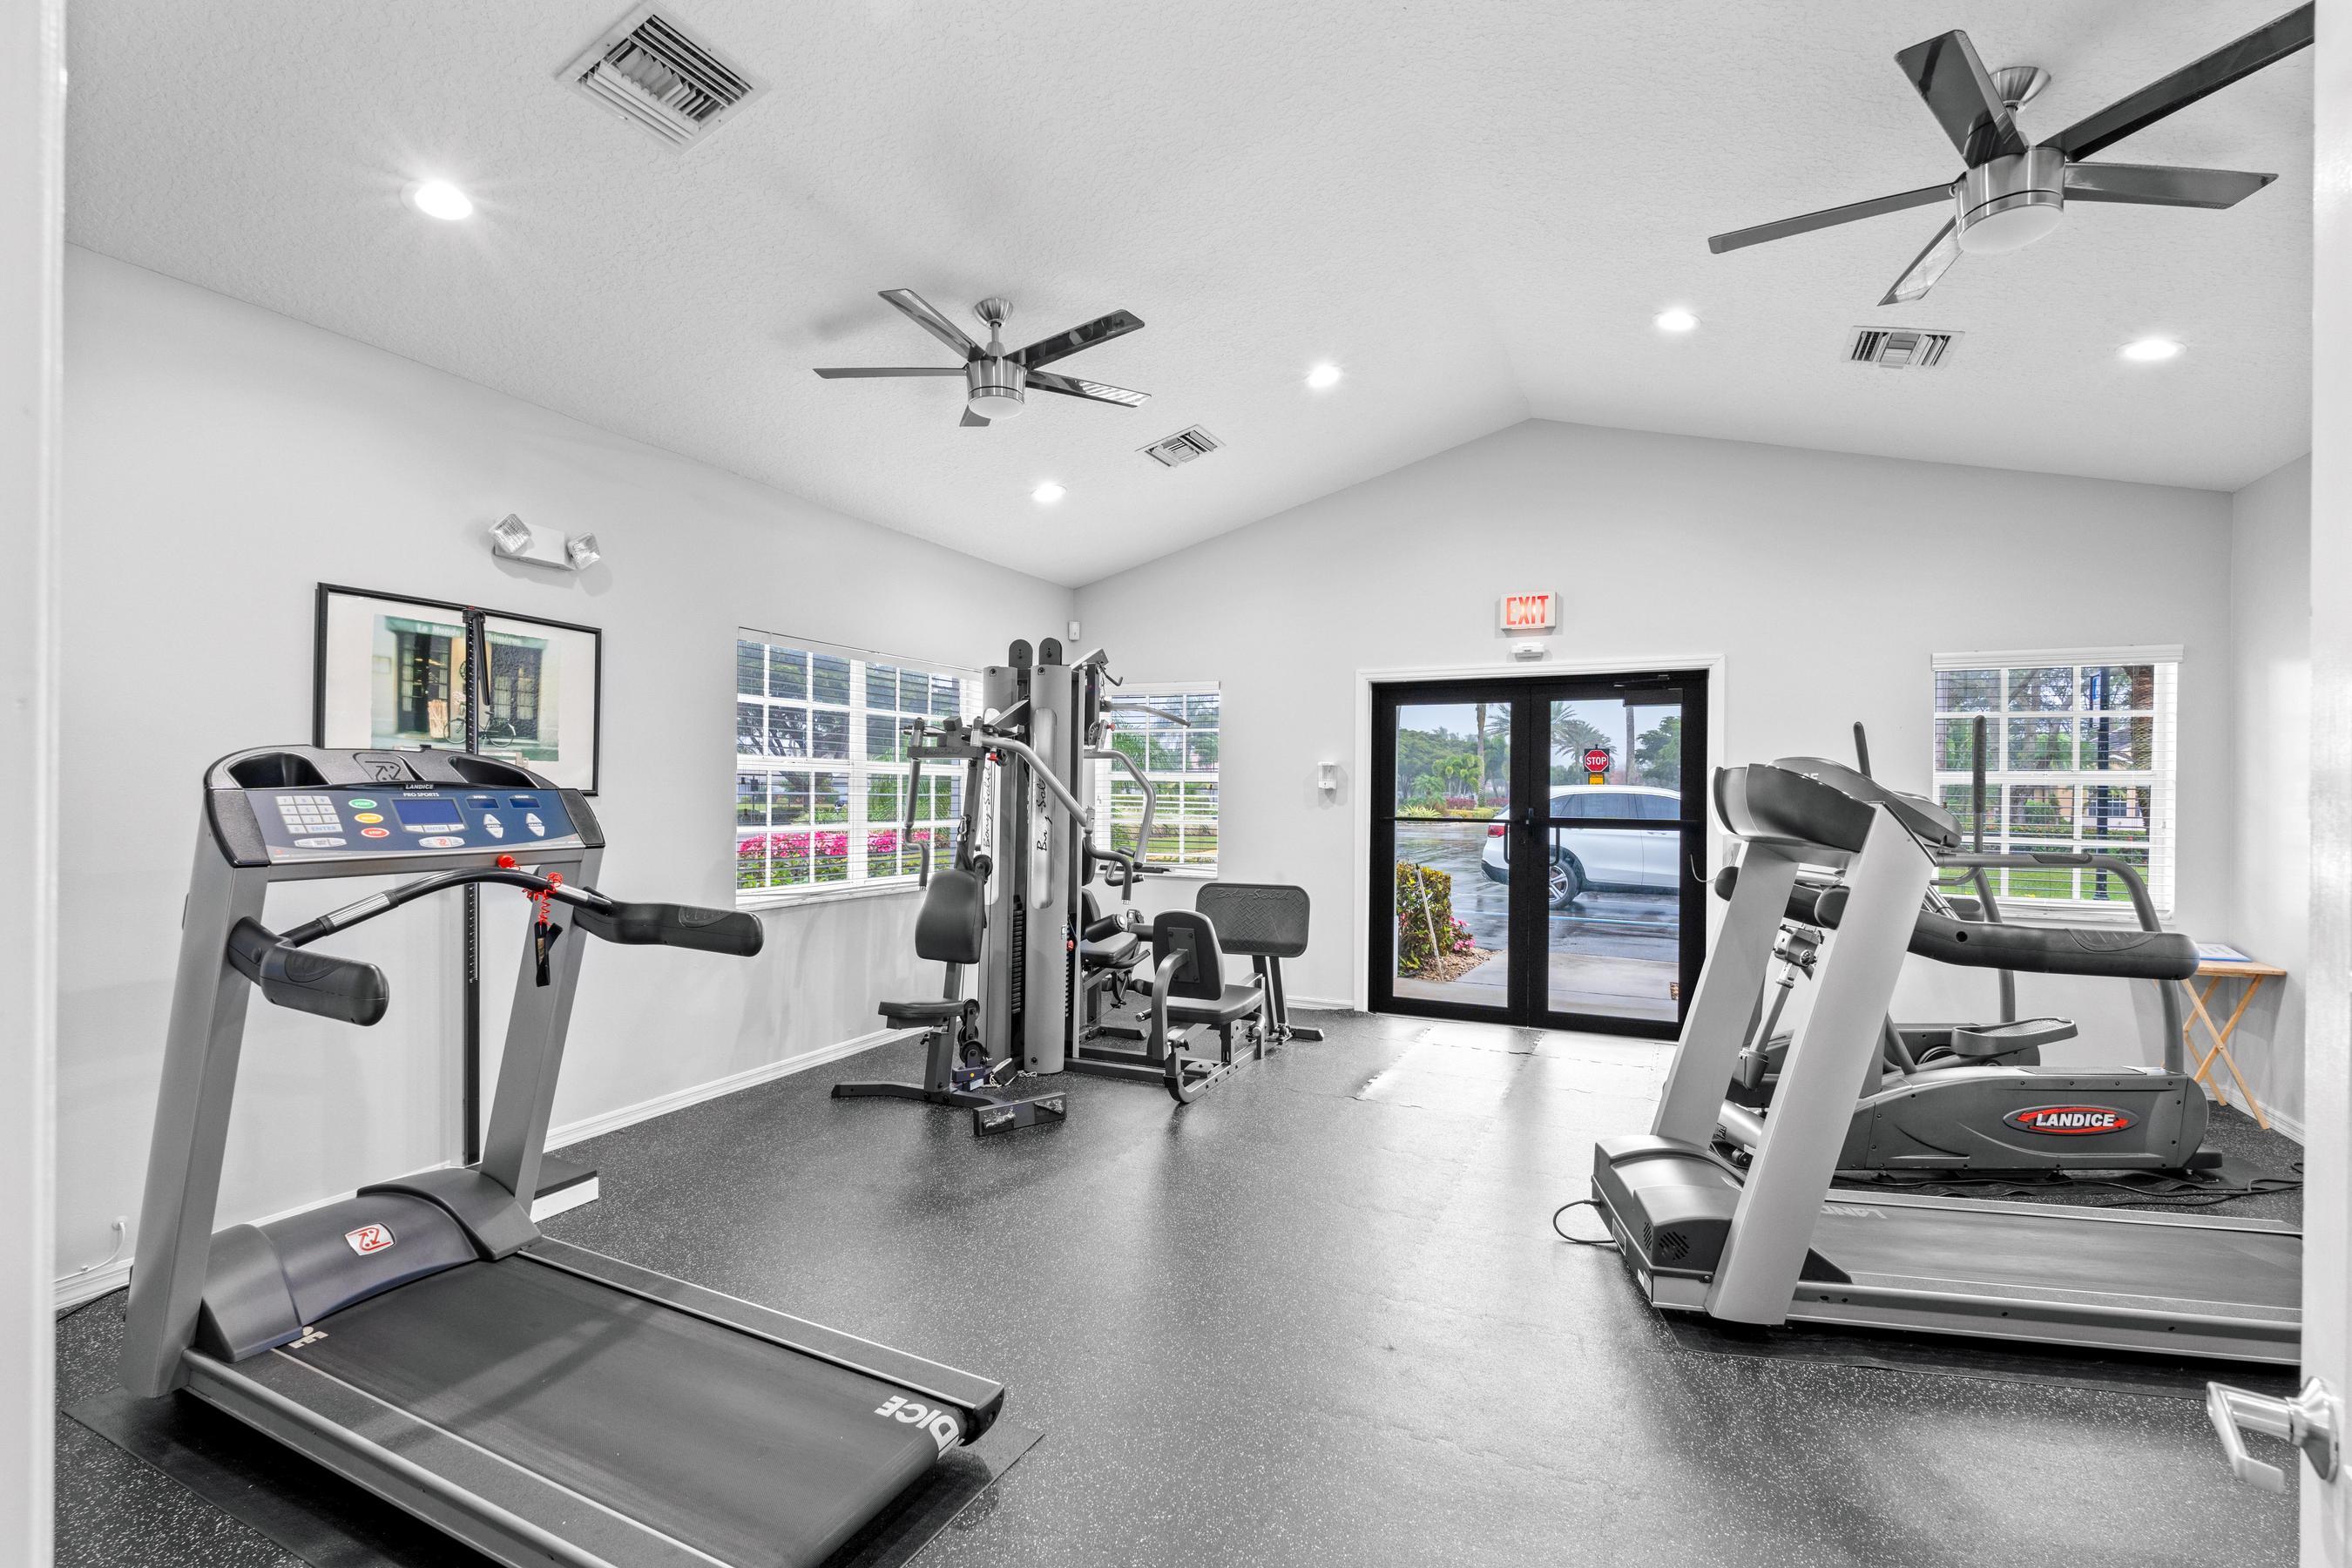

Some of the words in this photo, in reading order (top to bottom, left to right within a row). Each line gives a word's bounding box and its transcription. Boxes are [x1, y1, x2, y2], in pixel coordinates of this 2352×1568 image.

[1506, 595, 1549, 625] EXIT
[1586, 756, 1606, 766] STOP
[2036, 1113, 2115, 1127] LANDICE
[874, 1396, 961, 1455] DICE
